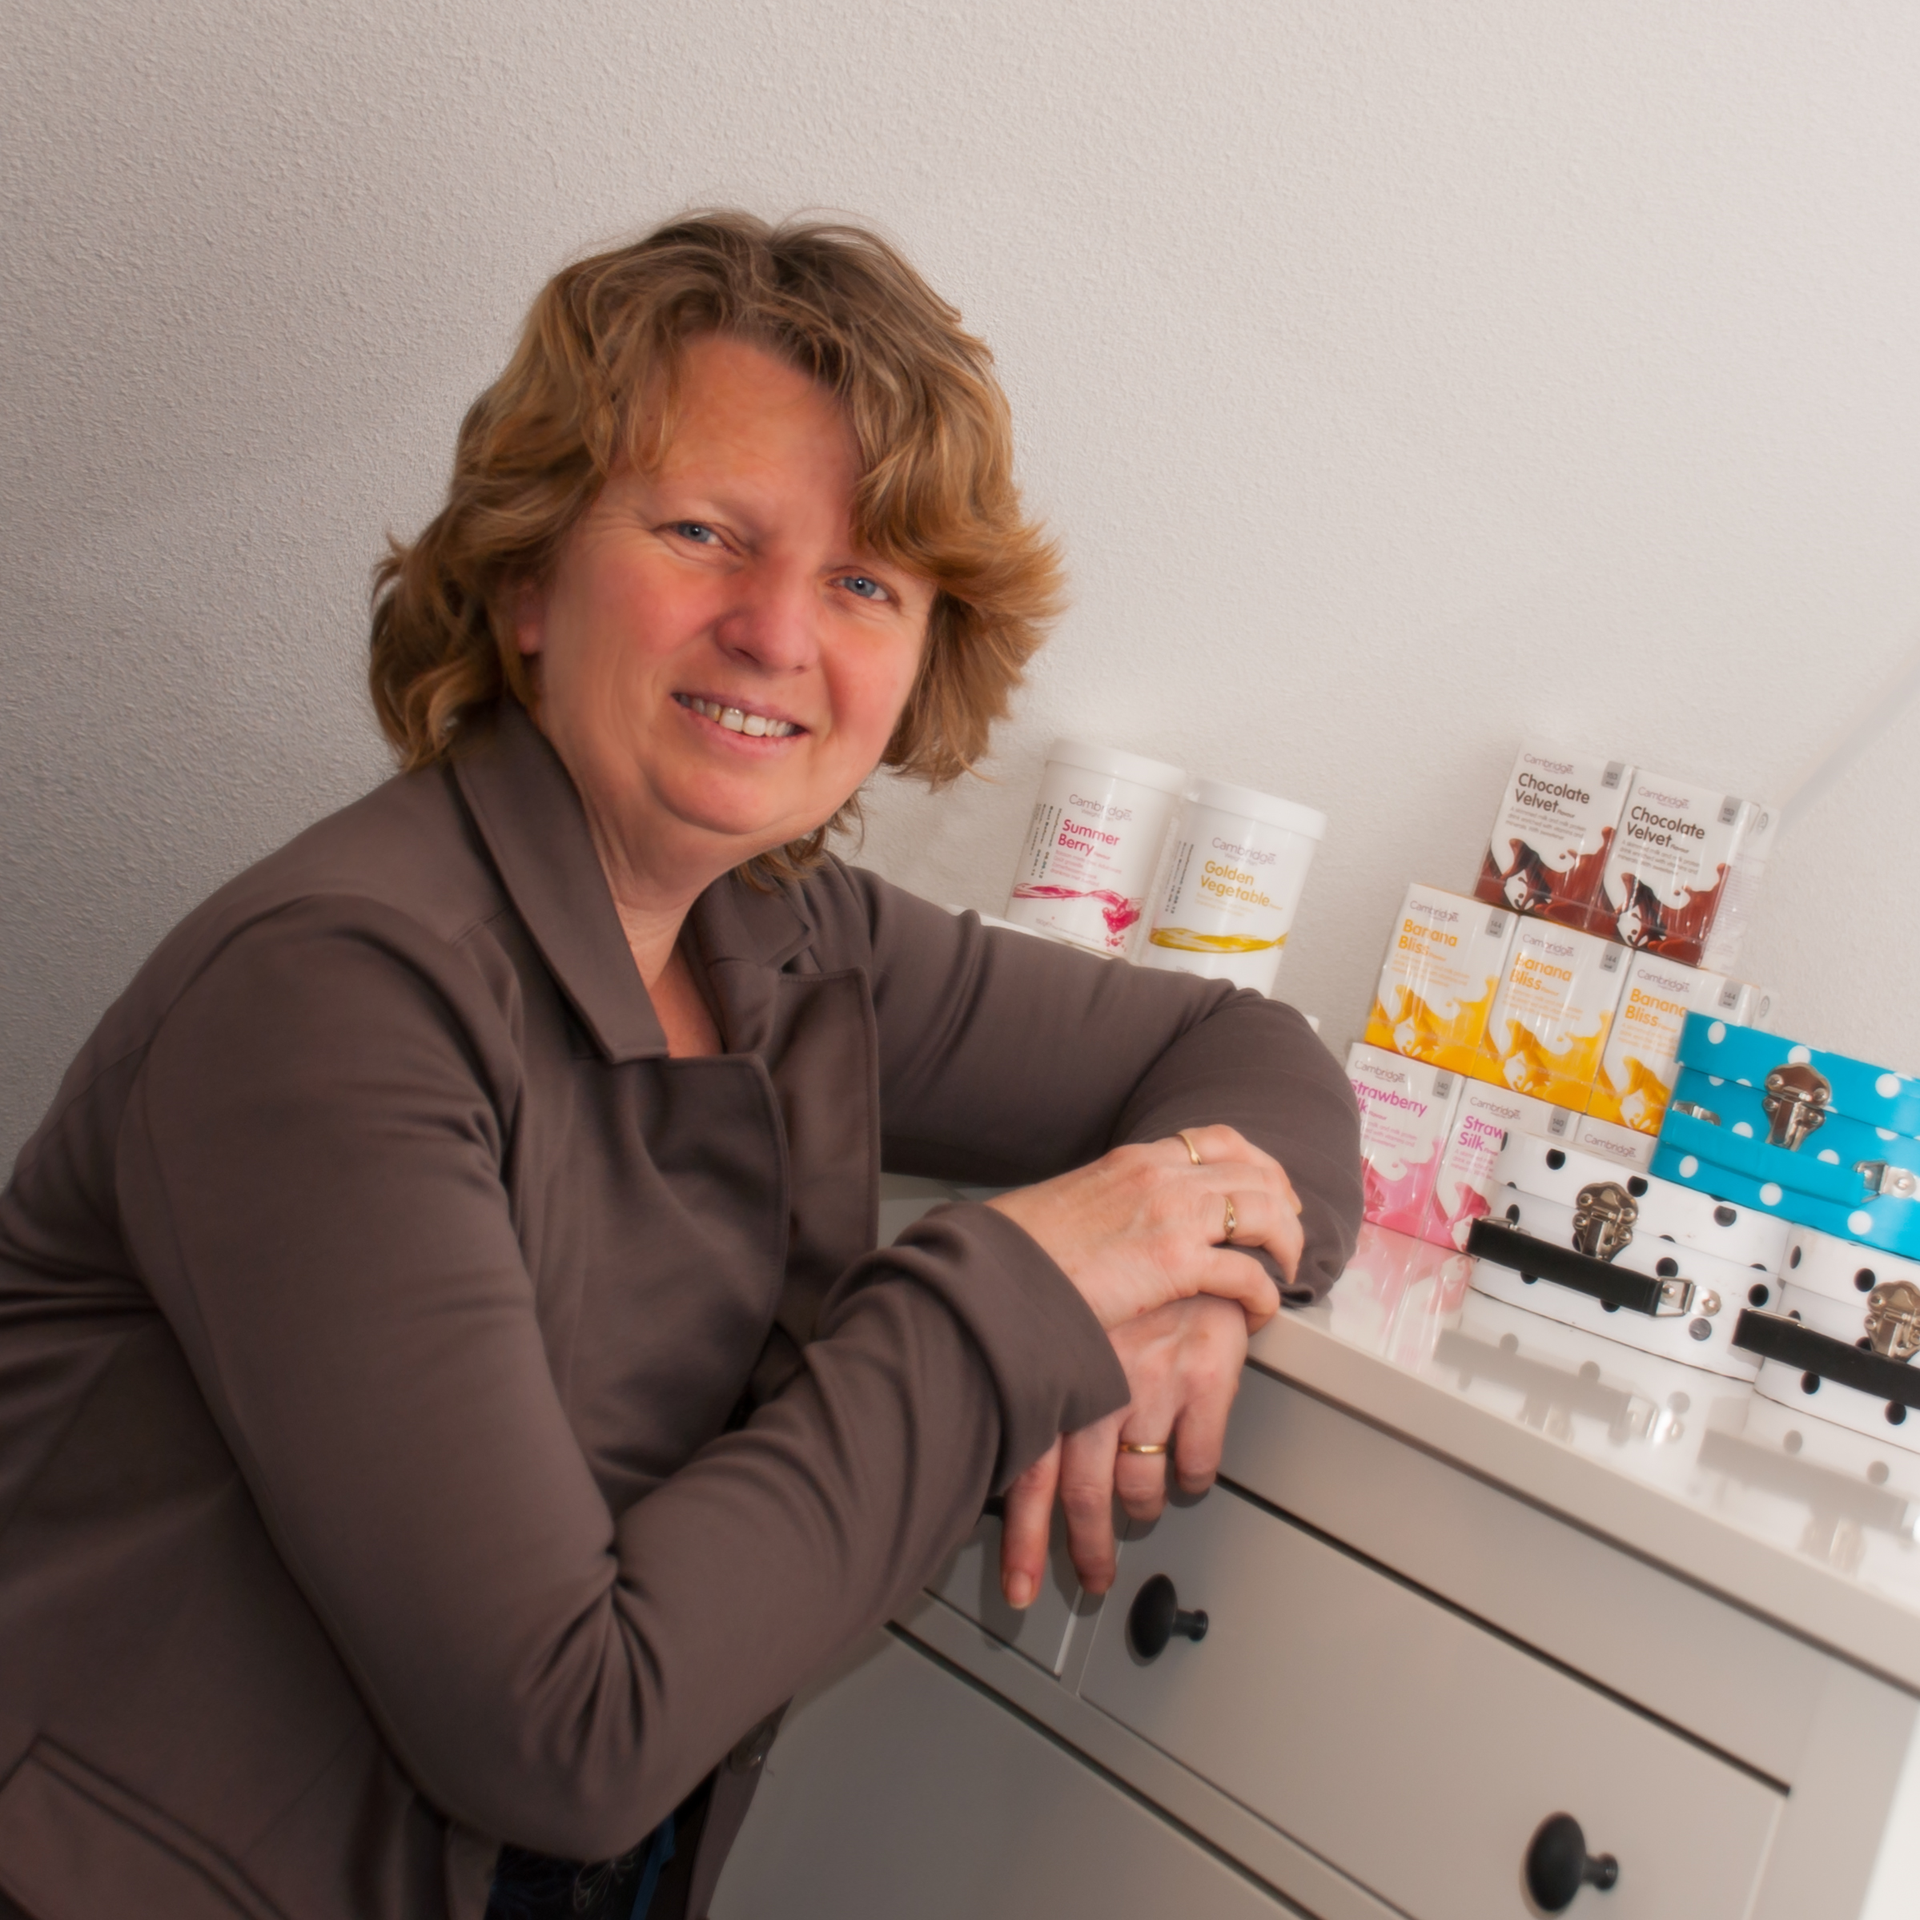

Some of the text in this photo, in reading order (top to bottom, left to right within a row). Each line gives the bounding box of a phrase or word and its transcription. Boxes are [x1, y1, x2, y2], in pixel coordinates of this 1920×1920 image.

[1524, 753, 1574, 775] Cambridge
[1518, 773, 1590, 804] Chocolate
[1638, 786, 1689, 809] Cambridge
[1068, 794, 1131, 820] Cambrdge
[1516, 789, 1559, 813] Velvet
[1062, 819, 1119, 845] Summer
[1627, 822, 1672, 847] Velvet
[1631, 806, 1705, 839] Chocolate
[1058, 833, 1093, 856] Berry
[1209, 835, 1276, 863] Cambridge
[1204, 860, 1254, 884] Golden
[1201, 874, 1270, 906] Vegetable
[1410, 900, 1459, 922] Cambridge
[1403, 919, 1458, 947] Banana
[1398, 935, 1429, 956] Bliss
[1515, 953, 1572, 981] Banana
[1510, 969, 1541, 990] Bliss
[1637, 969, 1690, 992] Cambridge
[1630, 988, 1688, 1017] Banana
[1625, 1005, 1659, 1027] Bliss
[1355, 1061, 1405, 1083] Cambridge
[1350, 1079, 1427, 1118] Strawberry
[1357, 1098, 1368, 1113] lk
[1470, 1097, 1521, 1120] Cambridge
[1464, 1115, 1503, 1140] Straw
[1458, 1132, 1484, 1151] Silk
[1585, 1134, 1636, 1157] Cambridge
